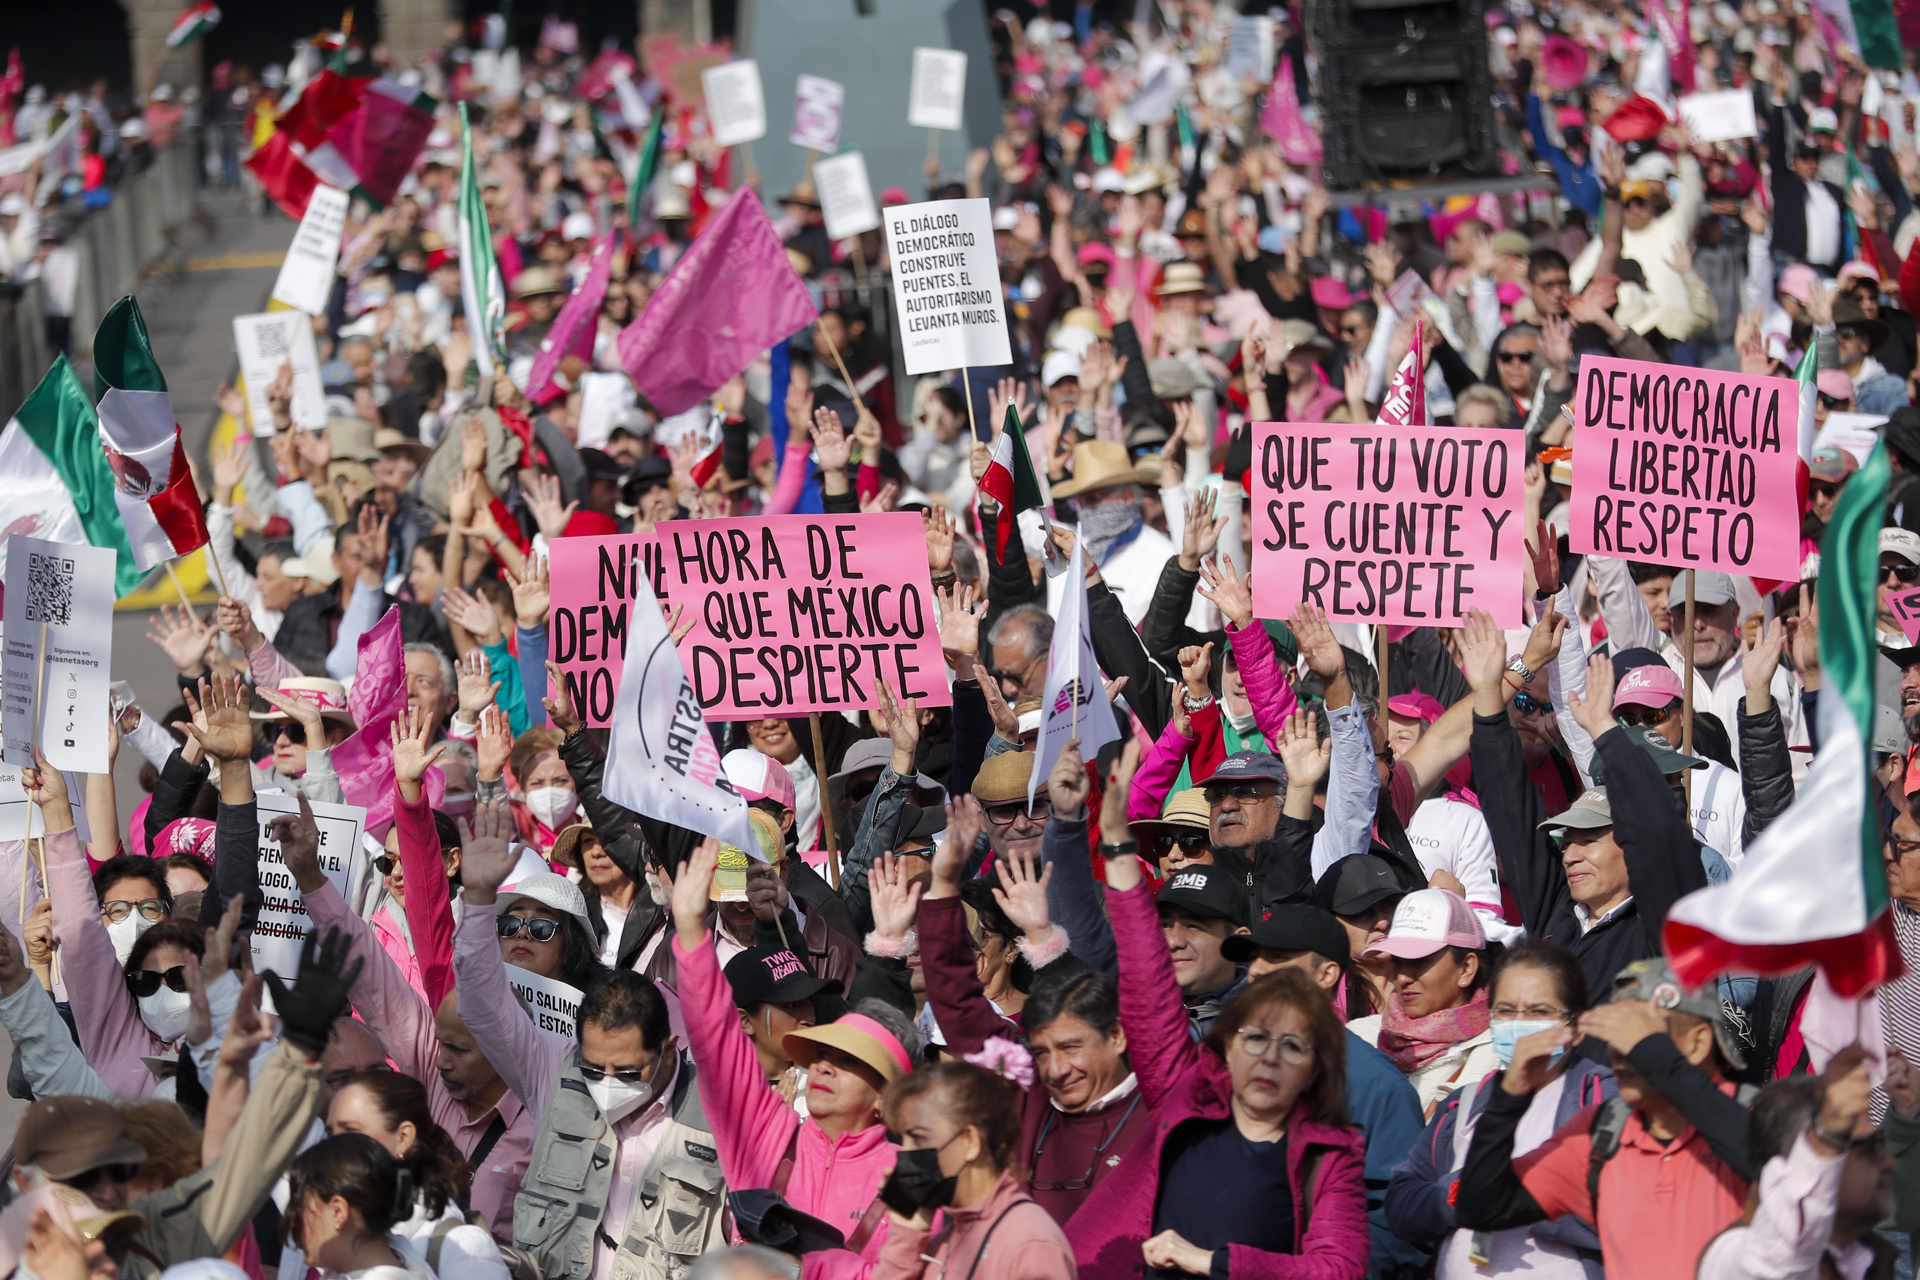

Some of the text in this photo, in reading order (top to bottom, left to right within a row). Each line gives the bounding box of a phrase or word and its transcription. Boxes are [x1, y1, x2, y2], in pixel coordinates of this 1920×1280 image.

[893, 213, 959, 236] EL DIÁLOGO
[896, 231, 975, 255] DEMOCRÁTICO
[899, 252, 967, 274] CONSTRUYE
[902, 272, 972, 294] PUENTES, EL
[906, 290, 993, 314] AUTORITARISMO
[908, 309, 1000, 333] LEVANTA MUROS.
[912, 337, 941, 347] LasNetas
[1585, 368, 1781, 453] DEMOCRACIA
[1262, 434, 1508, 498] QUE TU VOTO
[1609, 438, 1756, 508] LIBERTAD
[1263, 500, 1512, 561] SE CUENTE Y
[1593, 495, 1754, 567] RESPETO
[673, 524, 863, 585] HORA DE
[1302, 558, 1475, 619] RESPETE
[704, 579, 924, 642] QUE MÉXICO
[45, 654, 99, 668] @lasnetasorg
[692, 643, 929, 709] DESPIERTE
[565, 667, 613, 723] NO
[328, 856, 341, 872] EL
[540, 1013, 573, 1038] ESTAS
